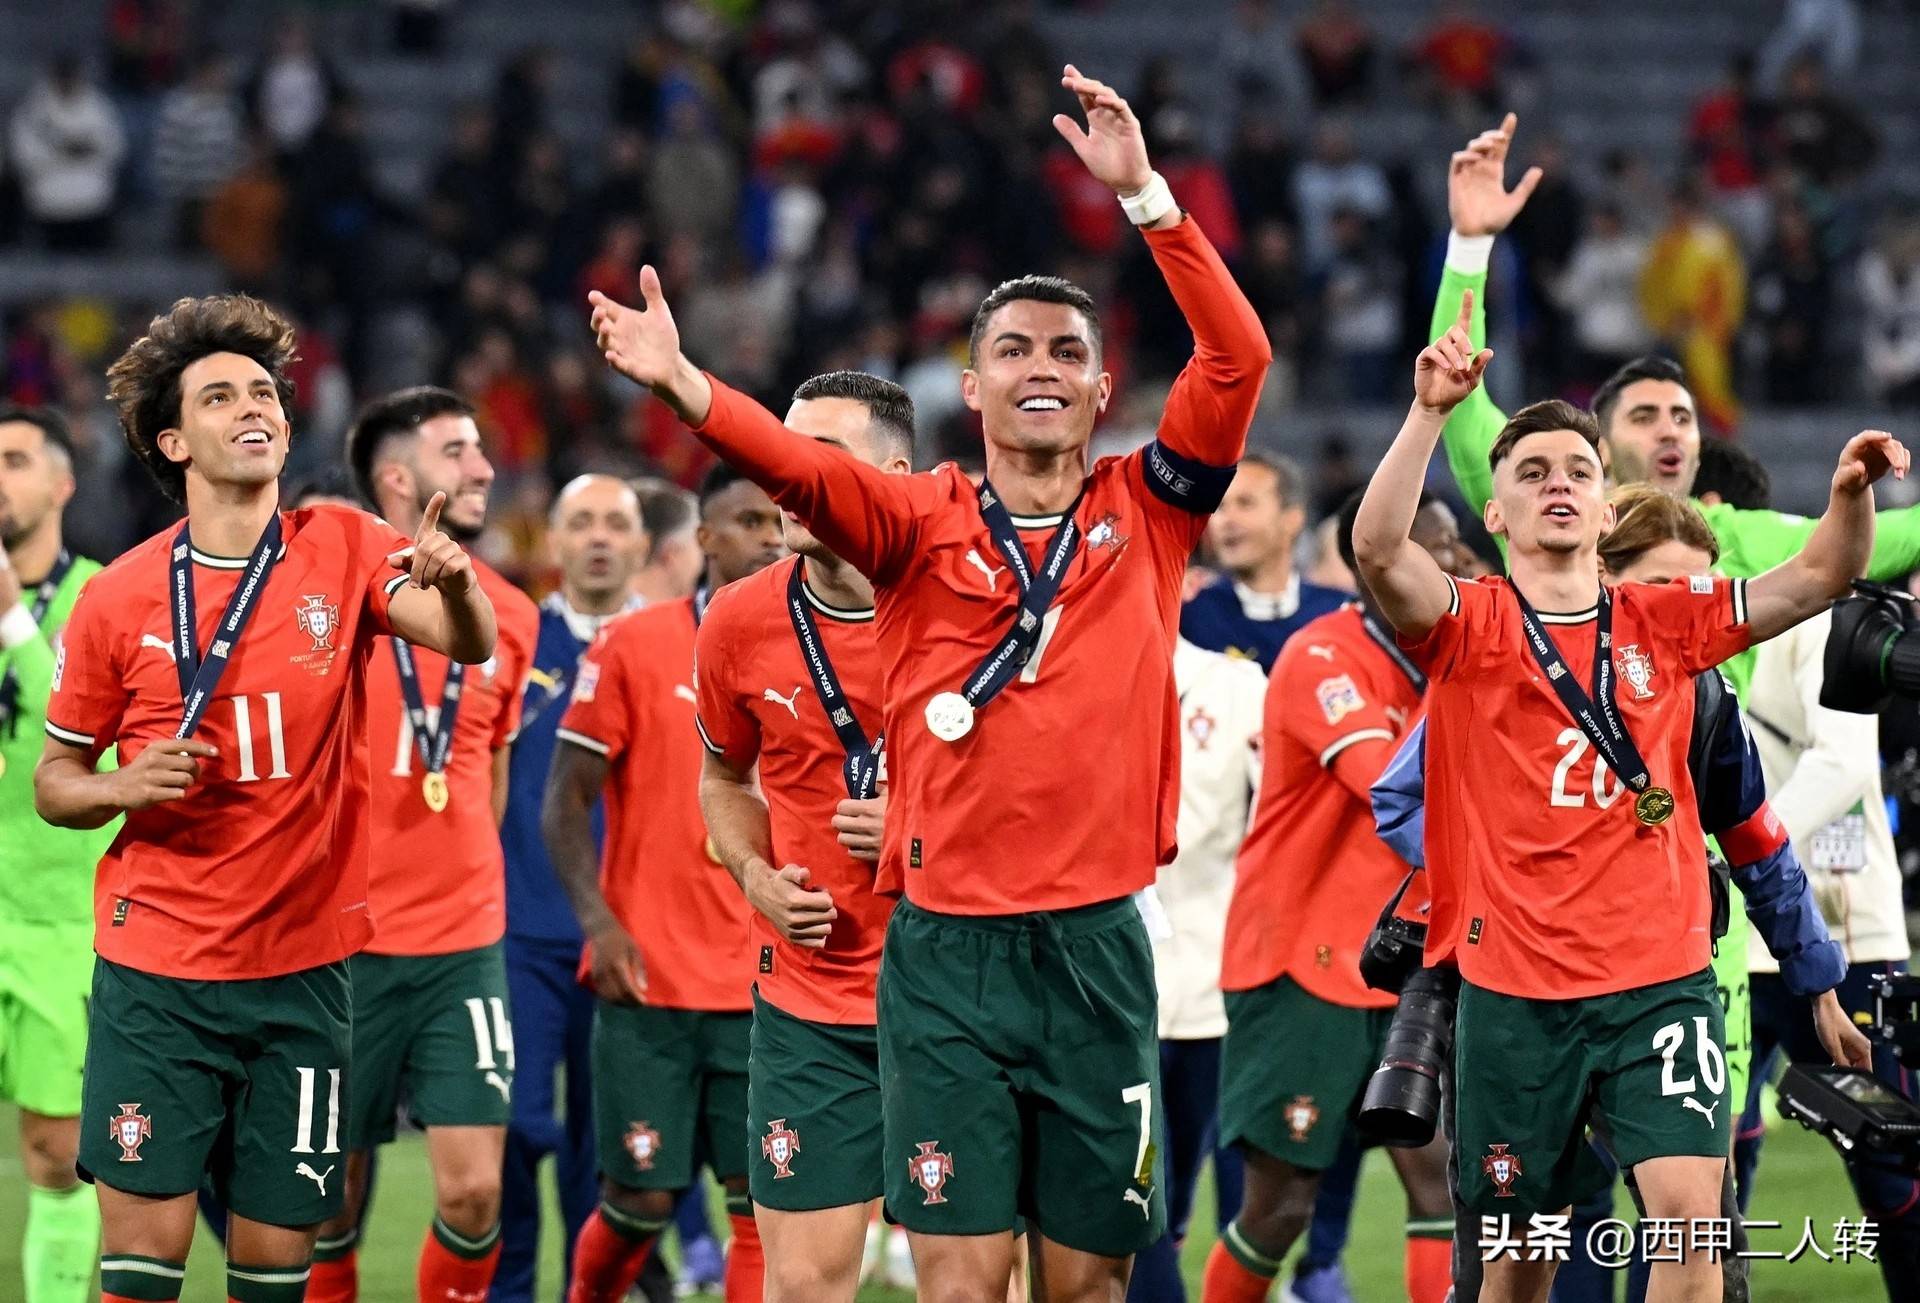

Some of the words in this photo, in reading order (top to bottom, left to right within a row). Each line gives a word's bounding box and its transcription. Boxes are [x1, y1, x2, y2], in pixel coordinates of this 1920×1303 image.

[1046, 544, 1067, 579] LEAGUE
[176, 569, 185, 590] UEFA
[226, 608, 242, 632] UEFA
[235, 576, 258, 612] NATIONS
[251, 544, 272, 578] LEAGUE
[177, 590, 187, 625] NATIONS
[792, 598, 811, 635] LEAGUE
[180, 625, 189, 658] LEAGUE
[803, 634, 825, 674] NATIONS
[997, 637, 1018, 662] UEFA
[1531, 633, 1548, 655] UEFA
[819, 673, 834, 698] UEFA
[970, 657, 1002, 695] NATIONS
[230, 691, 293, 782] 11
[1579, 707, 1605, 742] LEAGUE
[1604, 707, 1622, 741] LEAGUE
[861, 767, 873, 790] UEFA
[464, 997, 515, 1071] 14
[1652, 1017, 1726, 1096] 26
[290, 1067, 340, 1153] 11
[1122, 1082, 1151, 1179] 7
